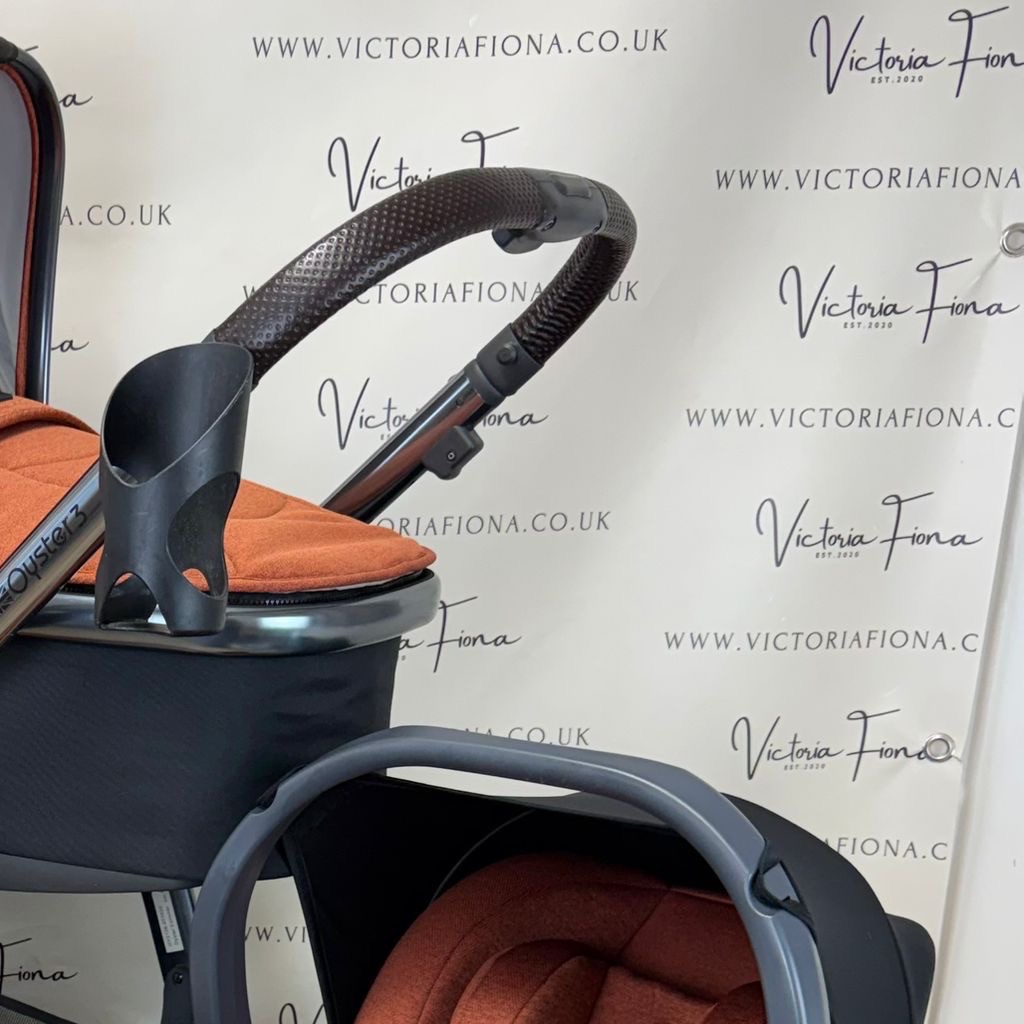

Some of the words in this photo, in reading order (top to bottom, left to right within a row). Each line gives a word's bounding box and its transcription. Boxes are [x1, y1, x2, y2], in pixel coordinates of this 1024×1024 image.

[252, 28, 668, 59] WWW.VICTORIAFIONA.CO.UK
[810, 15, 946, 95] Victoria
[948, 6, 1024, 98] Fion
[870, 75, 924, 84] EST.2020
[779, 265, 914, 339] Victoria
[915, 258, 1020, 344] Fiona
[7, 515, 73, 594] Oyster
[69, 503, 88, 528] 3
[756, 498, 878, 568] Victoria
[880, 492, 983, 572] Fiona
[428, 596, 522, 673] Fiona
[731, 716, 844, 780] Victoria
